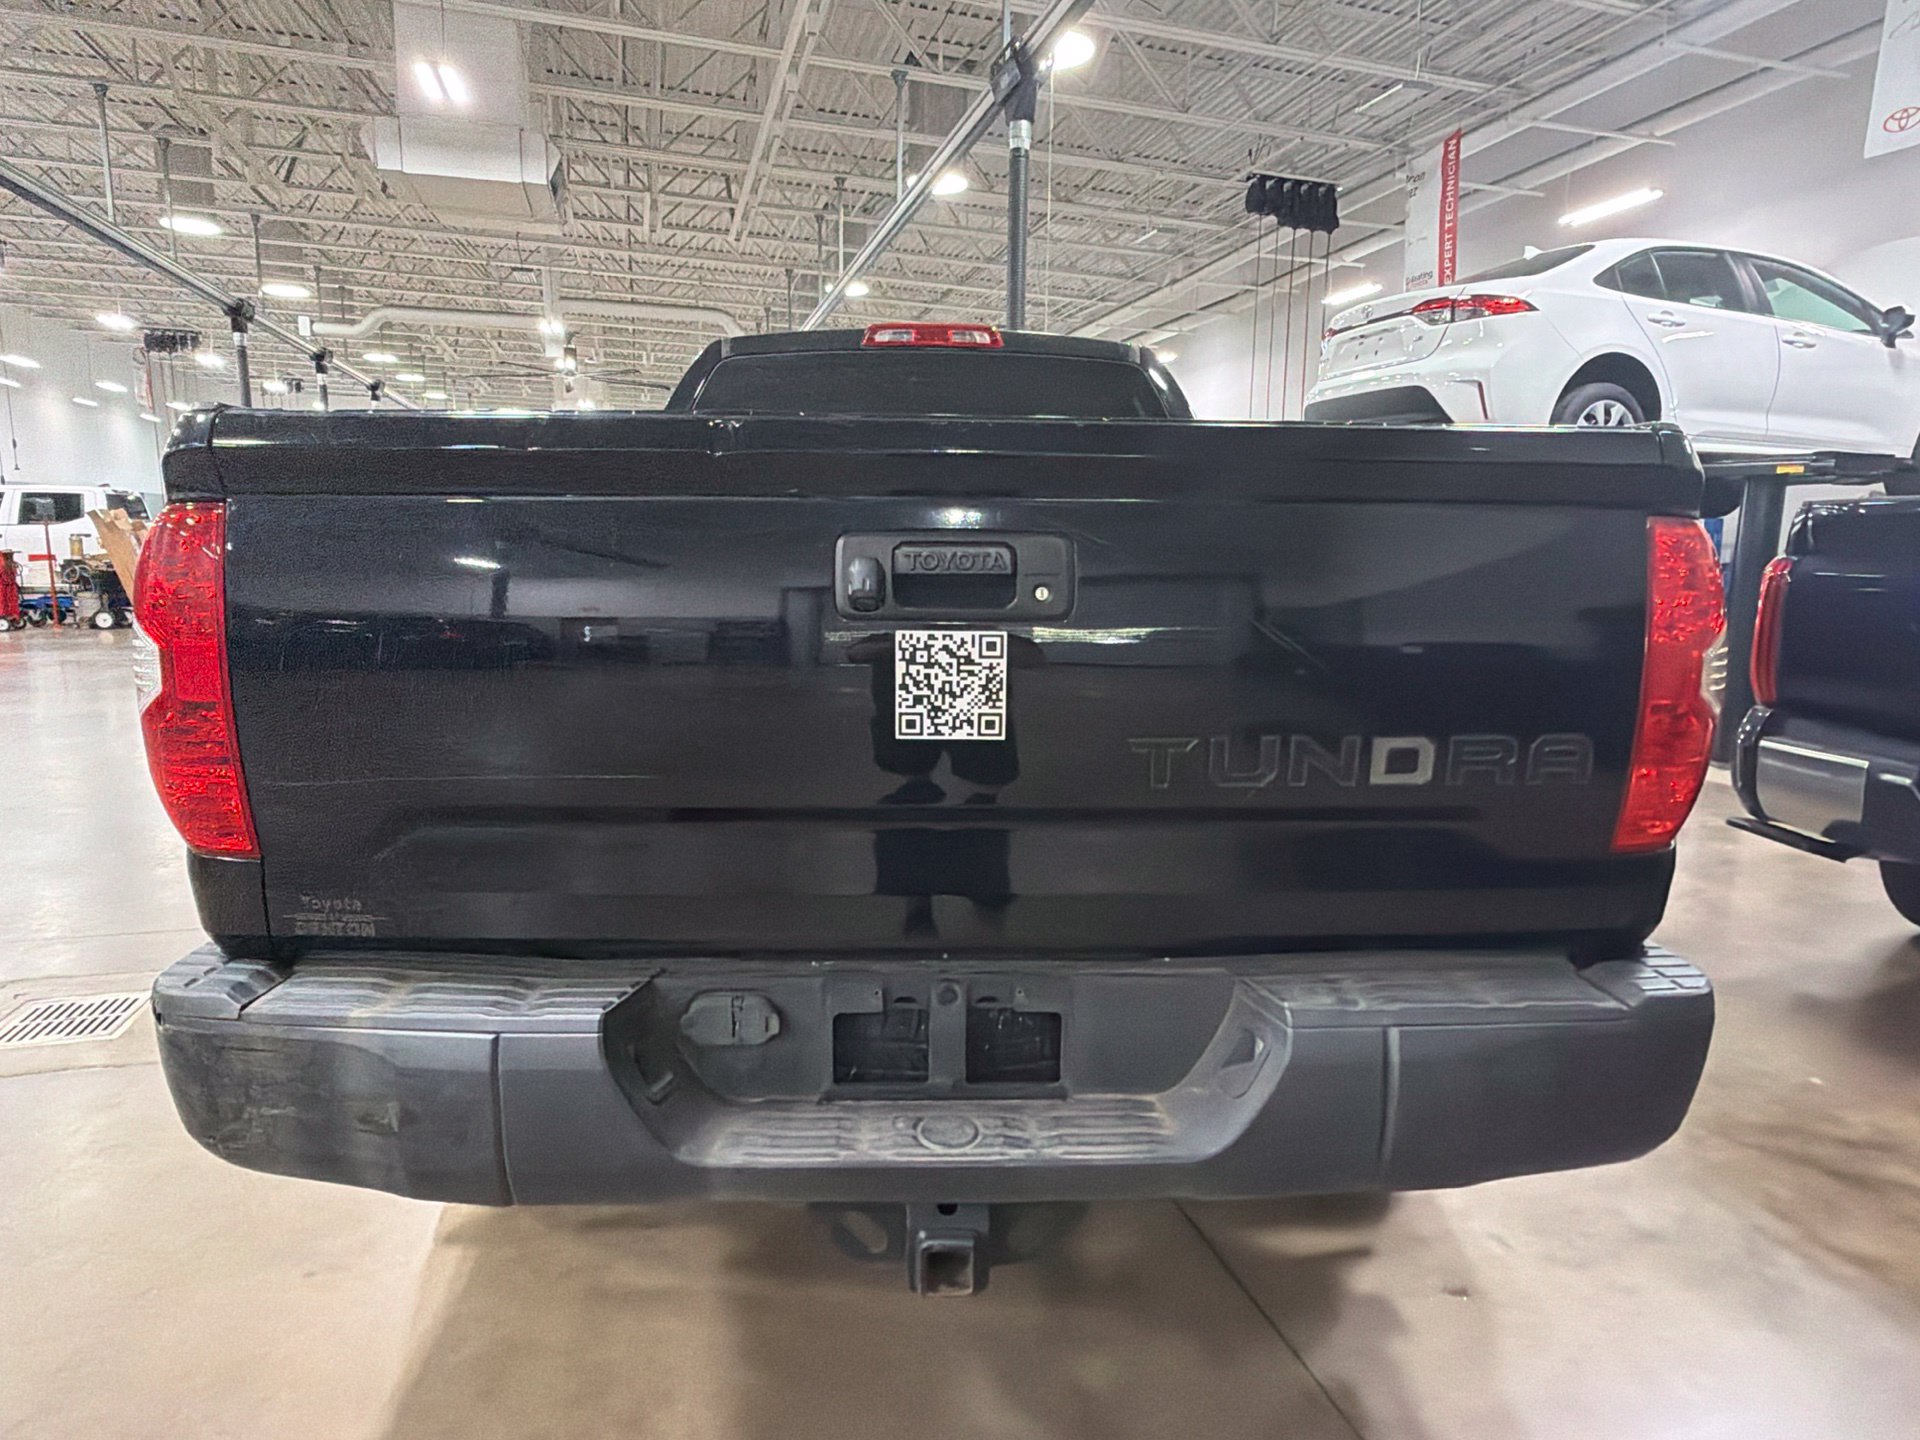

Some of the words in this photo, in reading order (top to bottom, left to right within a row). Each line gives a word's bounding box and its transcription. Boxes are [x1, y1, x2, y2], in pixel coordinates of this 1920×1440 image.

[1446, 139, 1457, 229] TECHNICIAN
[1444, 233, 1453, 285] EXPERT
[904, 551, 1007, 572] TOYOTA
[1127, 733, 1595, 789] TUNDRA
